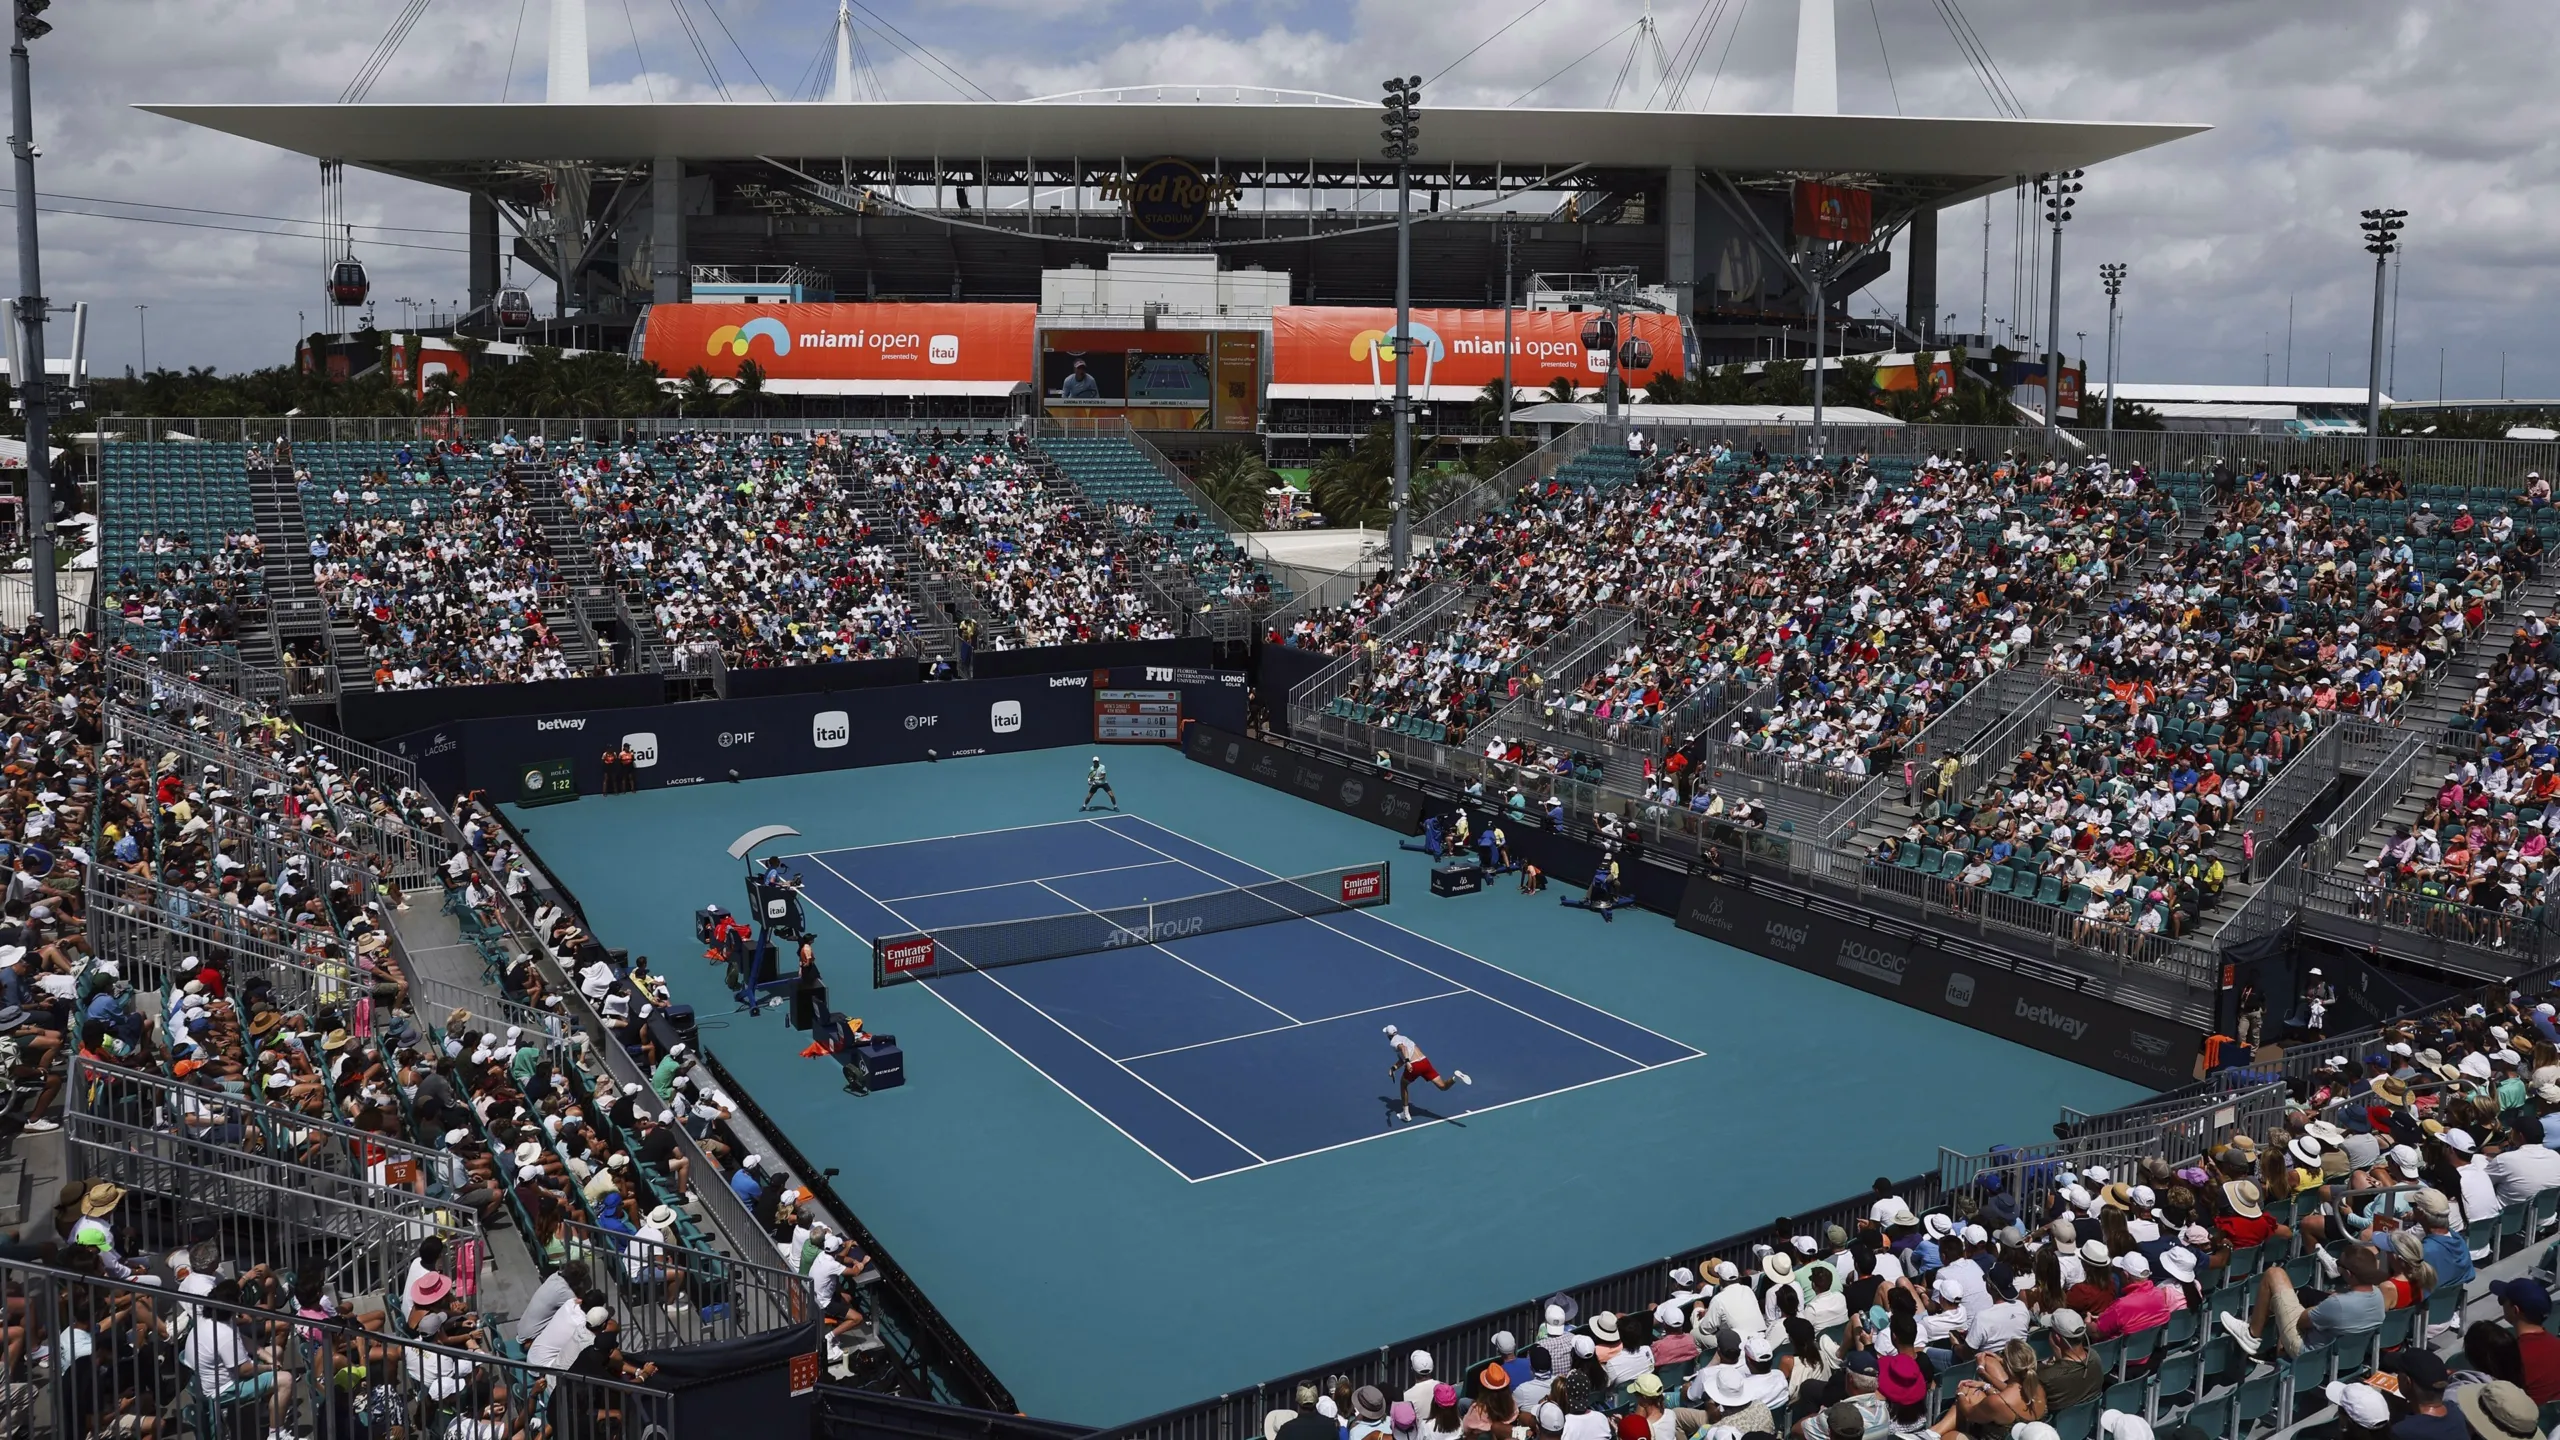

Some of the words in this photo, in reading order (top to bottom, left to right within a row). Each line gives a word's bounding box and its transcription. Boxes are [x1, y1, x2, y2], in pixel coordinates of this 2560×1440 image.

[1099, 175, 1168, 202] Hard
[1172, 176, 1236, 208] Rock
[1145, 214, 1192, 223] STADIUM
[800, 330, 864, 348] miami
[869, 333, 919, 352] open
[1454, 336, 1521, 355] miami
[1526, 341, 1577, 359] open
[932, 348, 955, 358] itaú
[1050, 676, 1087, 687] betway
[1146, 667, 1173, 682] FIU
[537, 718, 586, 731] betway
[919, 716, 938, 727] PIF
[994, 713, 1018, 727] itaú
[734, 732, 755, 744] PIF
[817, 726, 845, 742] itaú
[424, 741, 456, 757] LACOSTE
[632, 748, 654, 761] taú
[551, 769, 570, 777] ROLEX
[1252, 762, 1278, 778] LACOSTE
[552, 779, 570, 790] 1:22
[667, 777, 695, 785] LACOSTE
[1344, 877, 1378, 889] Emirates
[1349, 888, 1357, 896] FLY
[1357, 886, 1373, 895] BETTER
[770, 907, 785, 915] itaú
[1691, 908, 1733, 931] Protective
[1101, 925, 1149, 947] ATP
[1153, 917, 1203, 940] TOUR
[1770, 937, 1797, 952] SOLAR
[887, 944, 932, 960] Emirates
[1839, 939, 1906, 973] HOLOGIC
[894, 958, 904, 968] FLY
[905, 954, 925, 966] BETTER
[1949, 985, 1971, 1002] itaú
[2015, 997, 2088, 1040] betway
[2113, 1049, 2177, 1077] CADILLAC
[395, 1169, 406, 1178] 12
